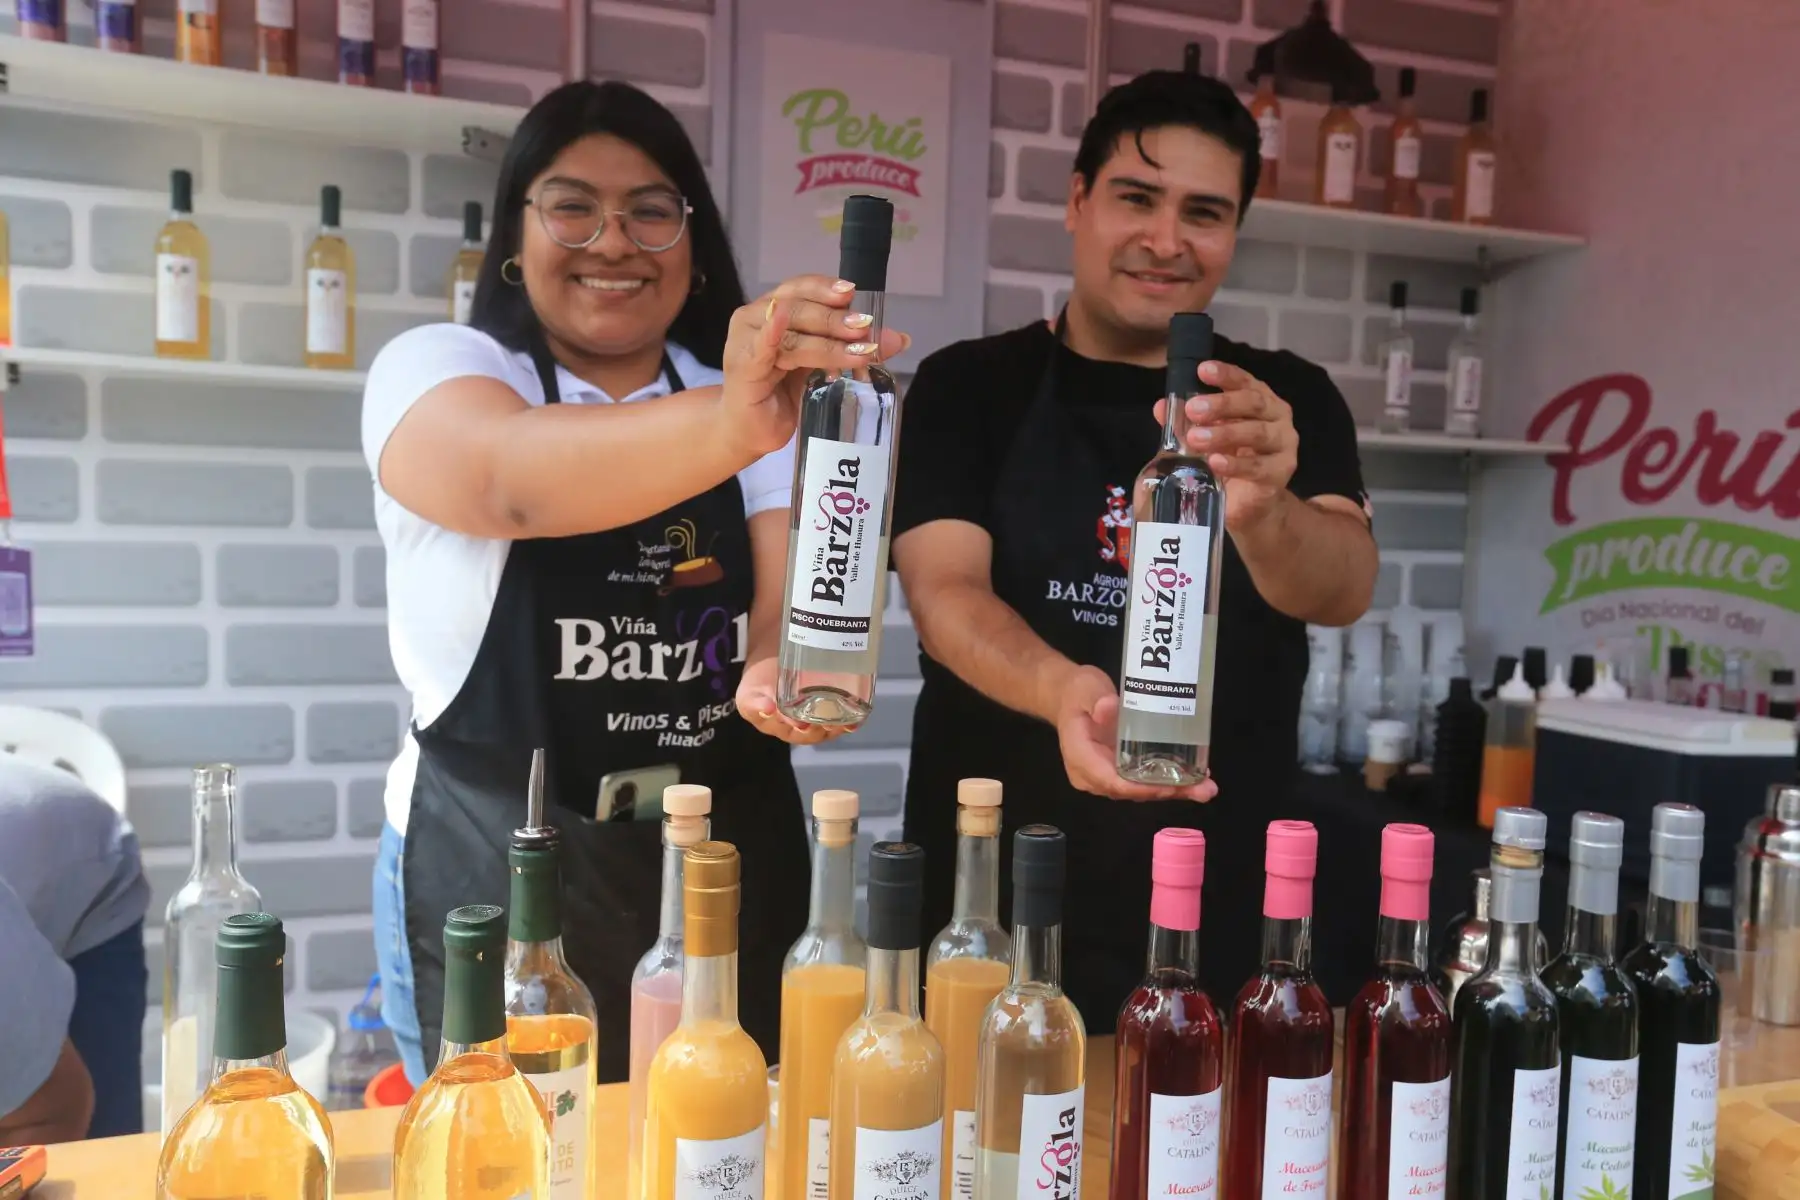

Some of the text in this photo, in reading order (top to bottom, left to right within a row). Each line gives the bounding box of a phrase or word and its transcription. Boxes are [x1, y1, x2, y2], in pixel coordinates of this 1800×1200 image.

[782, 87, 928, 161] Perú
[806, 158, 911, 188] produce
[811, 456, 861, 606] Barzola
[812, 547, 825, 572] Viña
[849, 518, 865, 583] Valle de Huaura
[1560, 521, 1790, 601] produce
[1140, 536, 1181, 672] Barzola
[611, 616, 657, 635] Viña
[792, 611, 868, 628] PISCO QUEBRANTA
[1072, 608, 1118, 626] VINOS
[1618, 599, 1720, 624] Nacional
[1724, 611, 1767, 636] del
[1141, 619, 1152, 642] Viña
[1175, 632, 1183, 651] Valle
[1126, 680, 1194, 694] PISCO QUEBRANTA
[606, 713, 669, 731] Vinos
[675, 716, 691, 730] &
